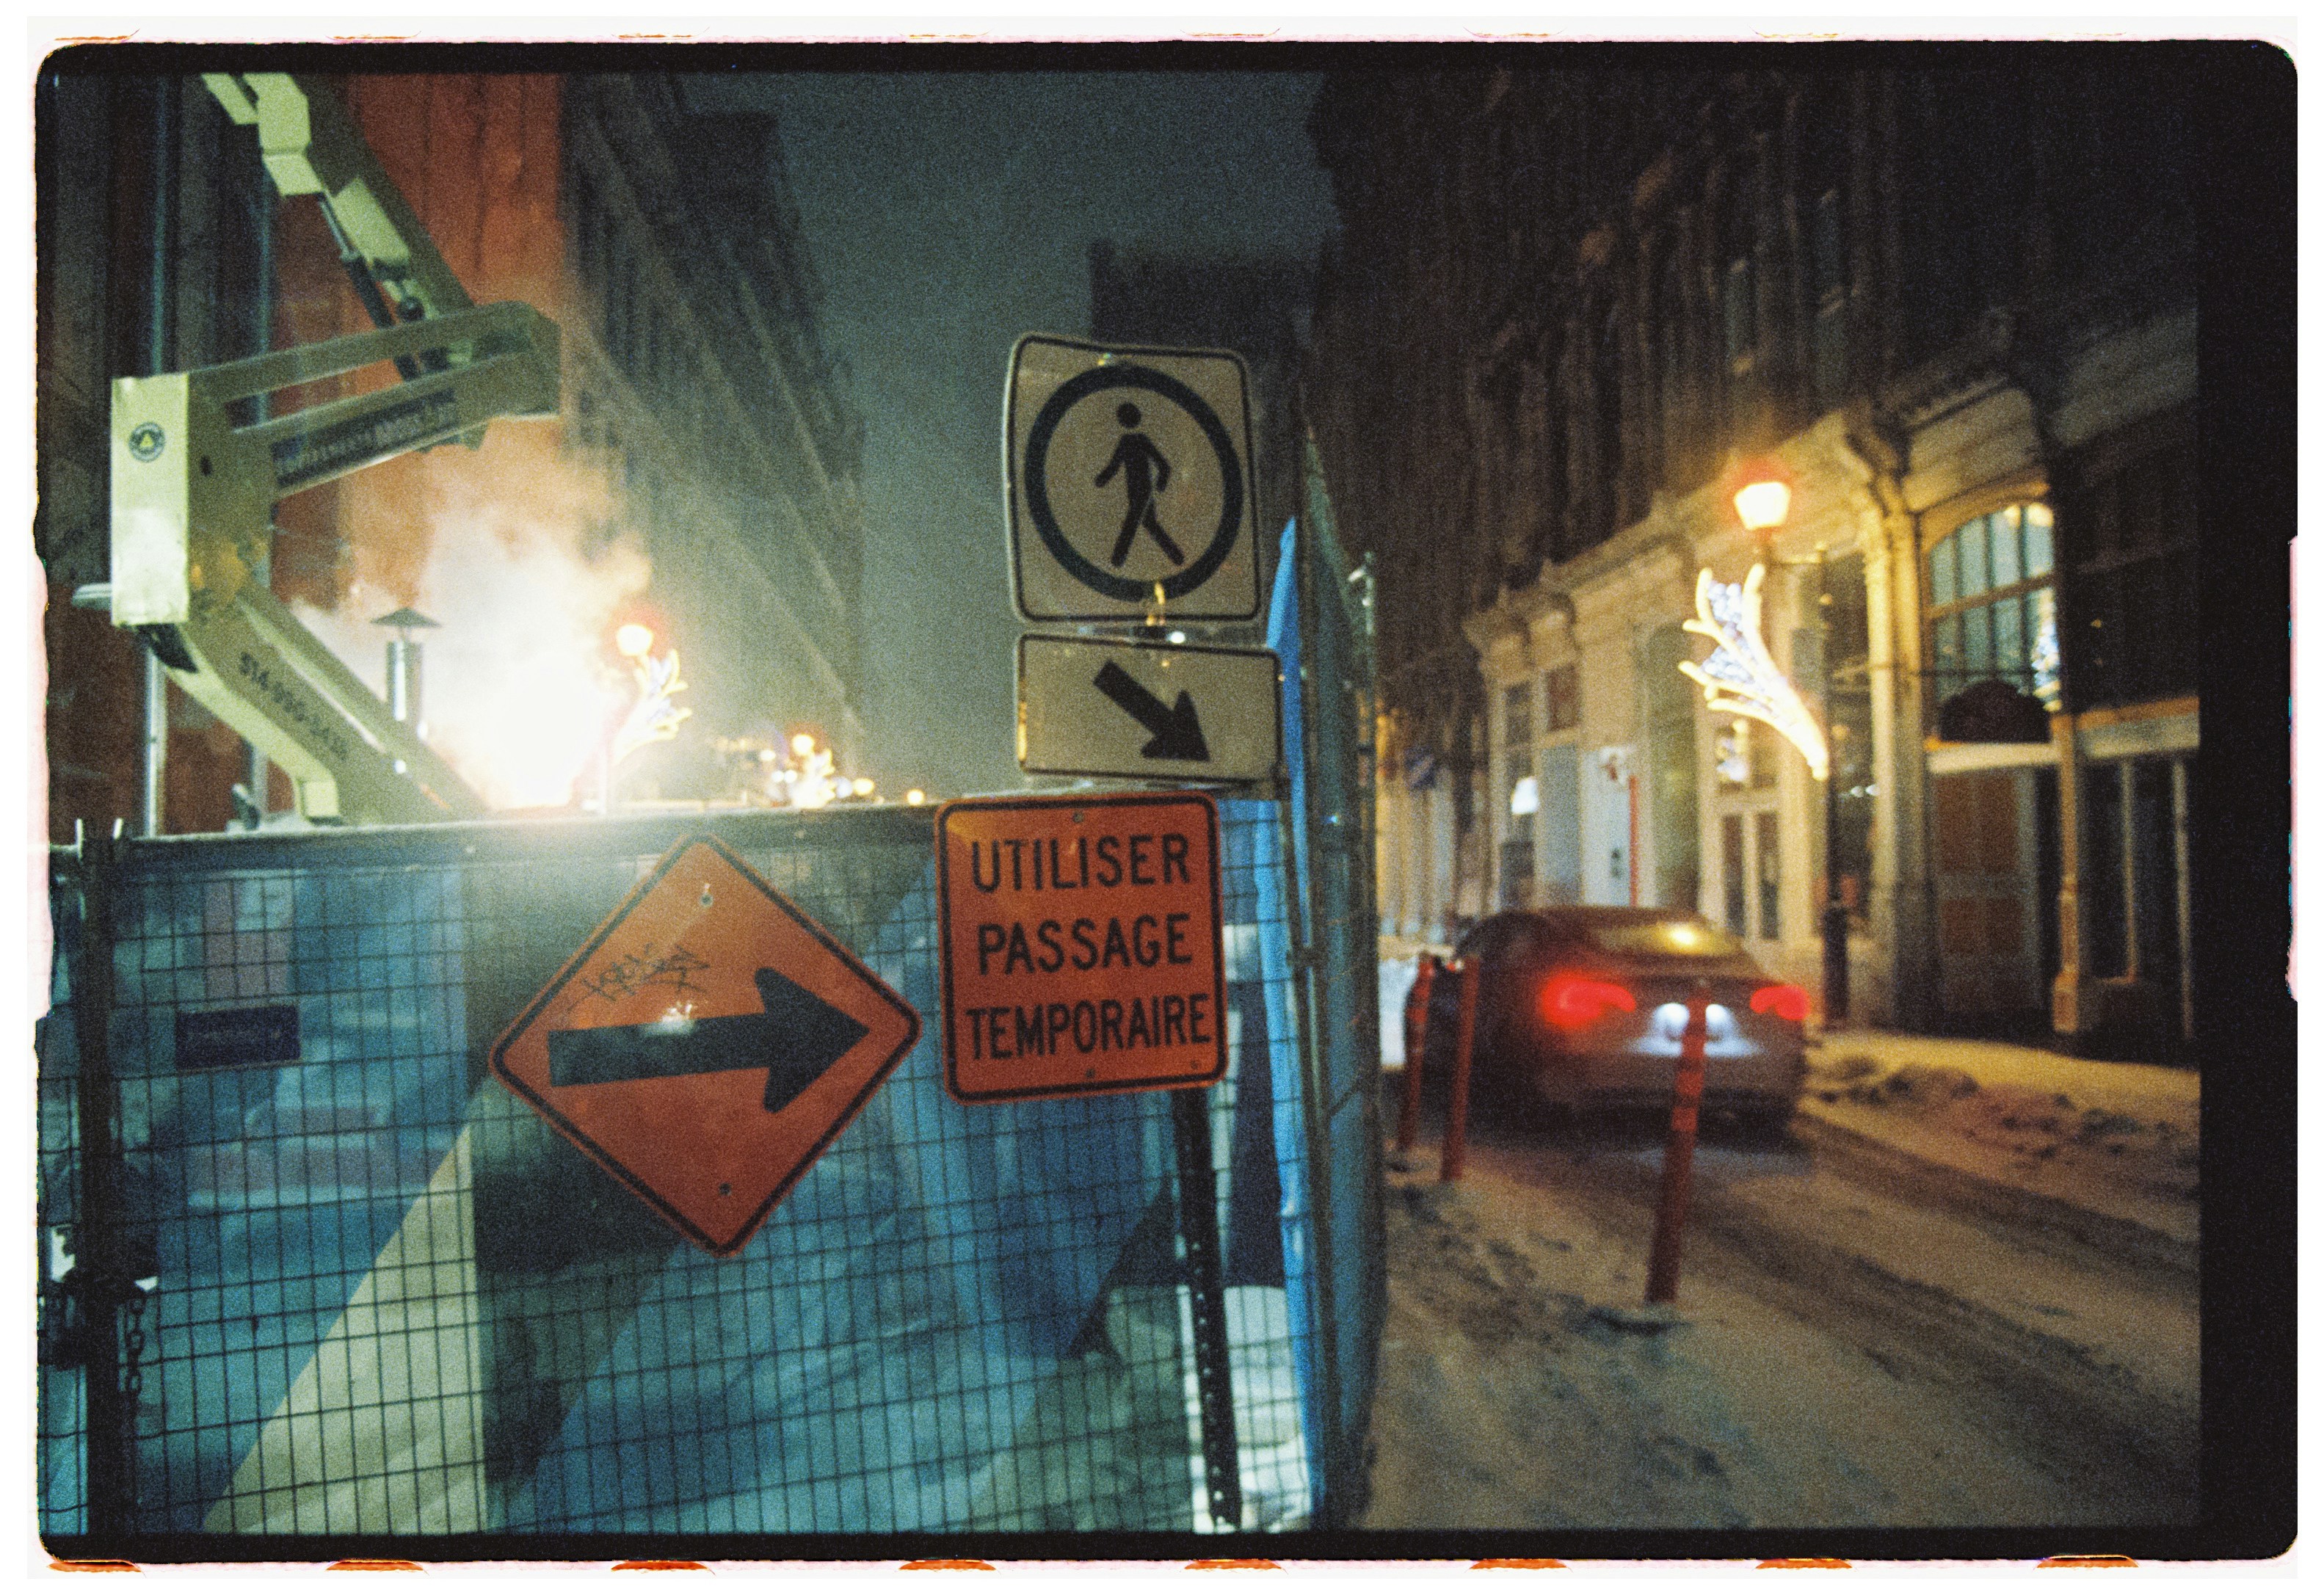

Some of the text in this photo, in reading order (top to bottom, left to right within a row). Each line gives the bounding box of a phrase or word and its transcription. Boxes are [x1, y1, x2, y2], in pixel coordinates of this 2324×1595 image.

[972, 833, 1191, 893] UTILISER
[978, 912, 1193, 975] PASSAGE
[965, 992, 1211, 1061] TEMPORAIRE
